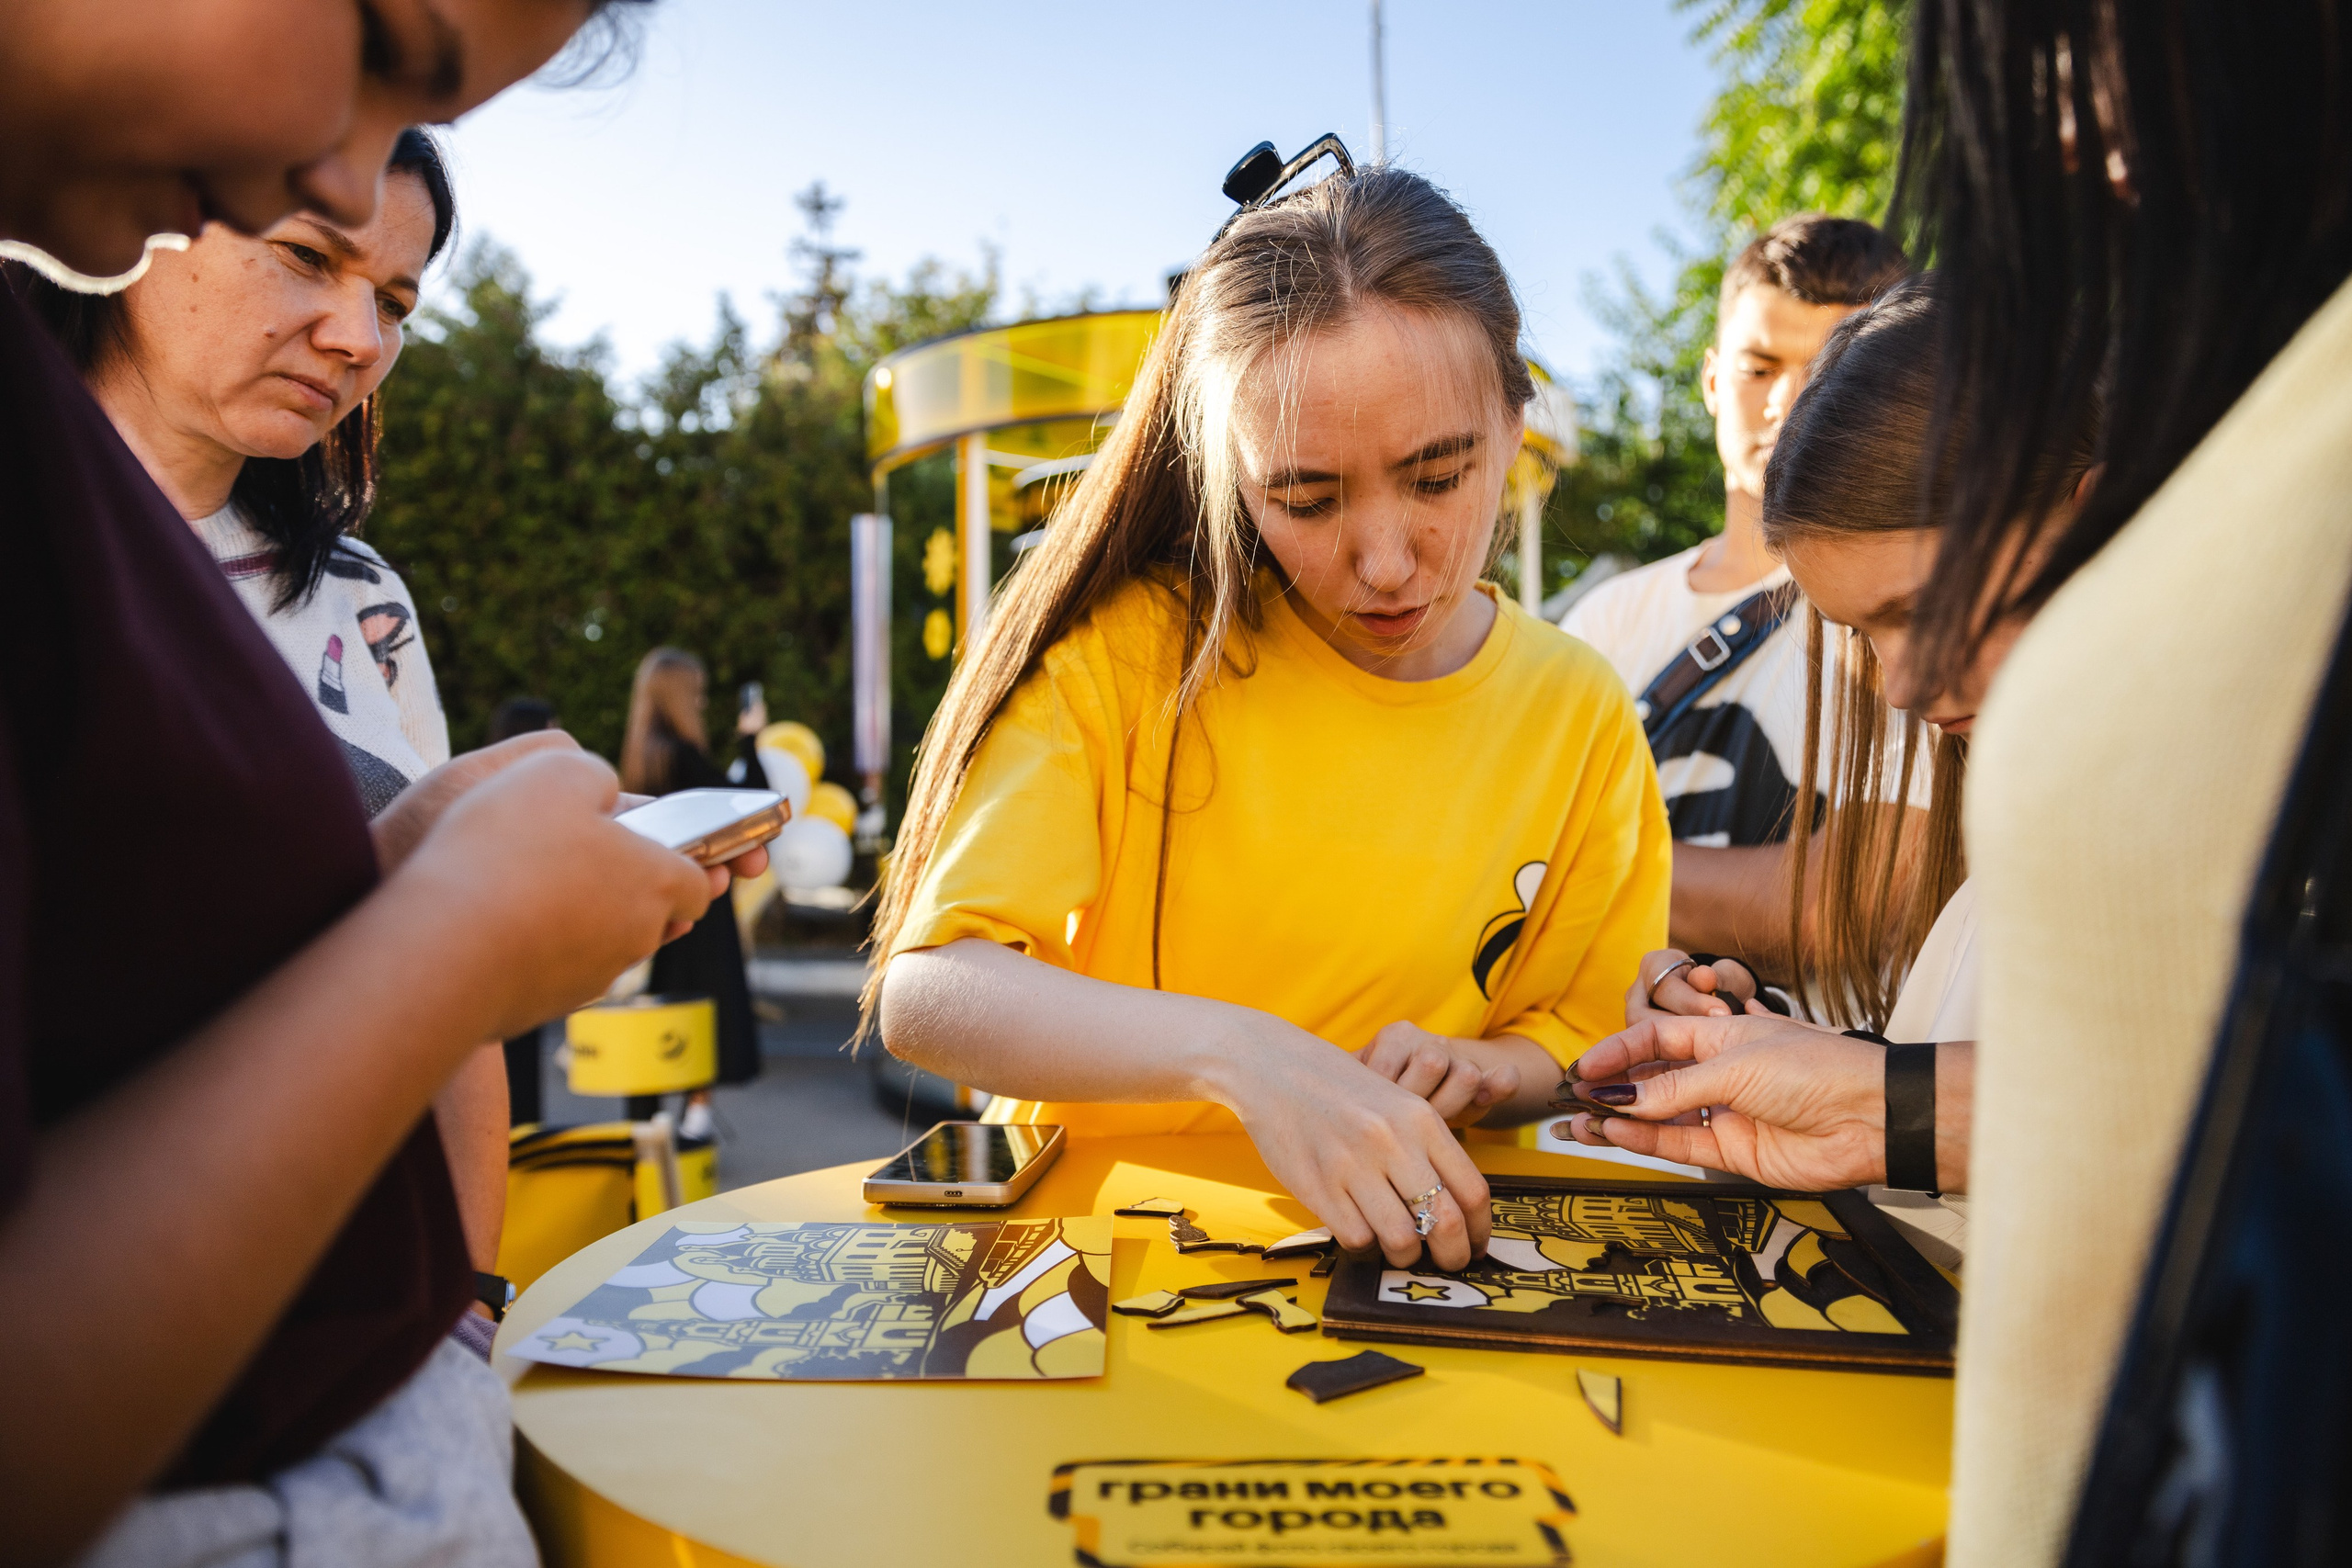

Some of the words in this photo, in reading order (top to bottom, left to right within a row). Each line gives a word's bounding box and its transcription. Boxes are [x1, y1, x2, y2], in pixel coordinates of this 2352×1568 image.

[1099, 1481, 1289, 1505] грани
[1306, 1481, 1521, 1500] моего
[1191, 1509, 1446, 1534] города
